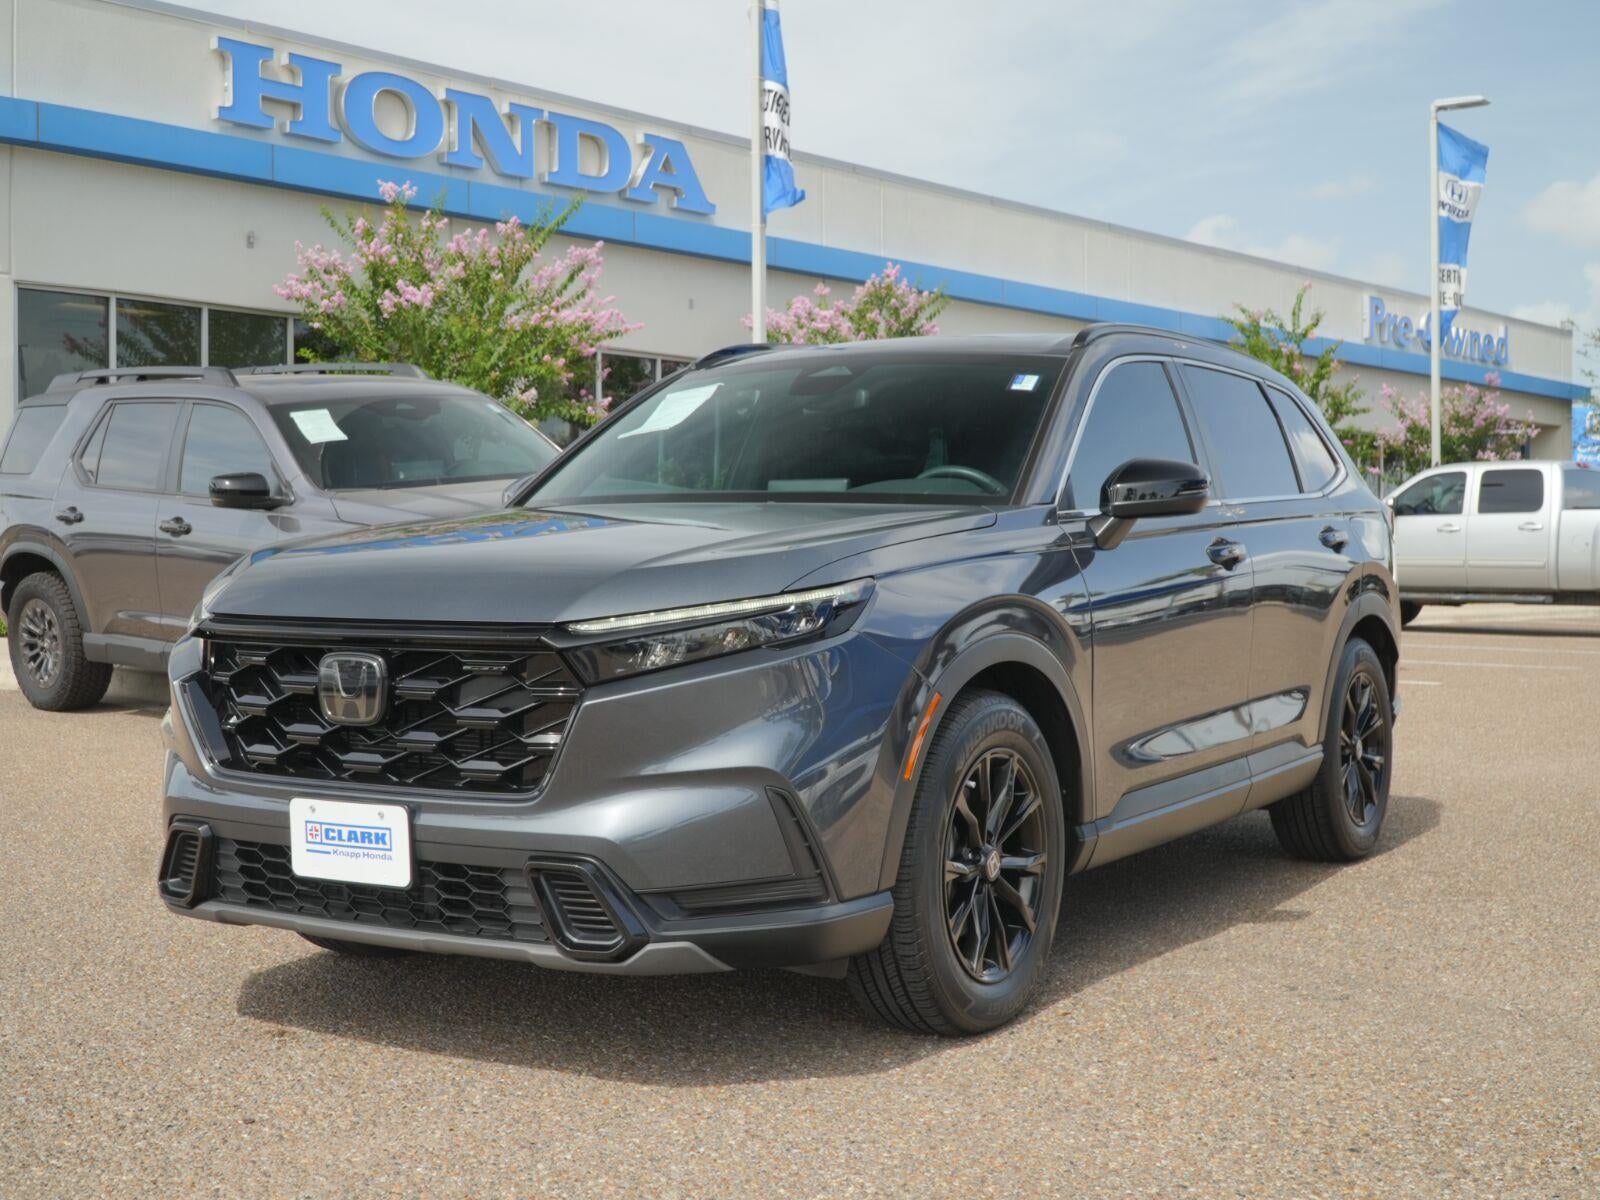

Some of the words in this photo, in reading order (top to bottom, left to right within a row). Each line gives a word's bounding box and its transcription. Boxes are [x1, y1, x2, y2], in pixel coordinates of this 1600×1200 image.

[211, 36, 716, 215] HONDA
[1364, 295, 1509, 366] Pre-wned
[324, 827, 388, 846] CLARK
[332, 848, 361, 860] Knapp
[362, 850, 393, 861] Honda
